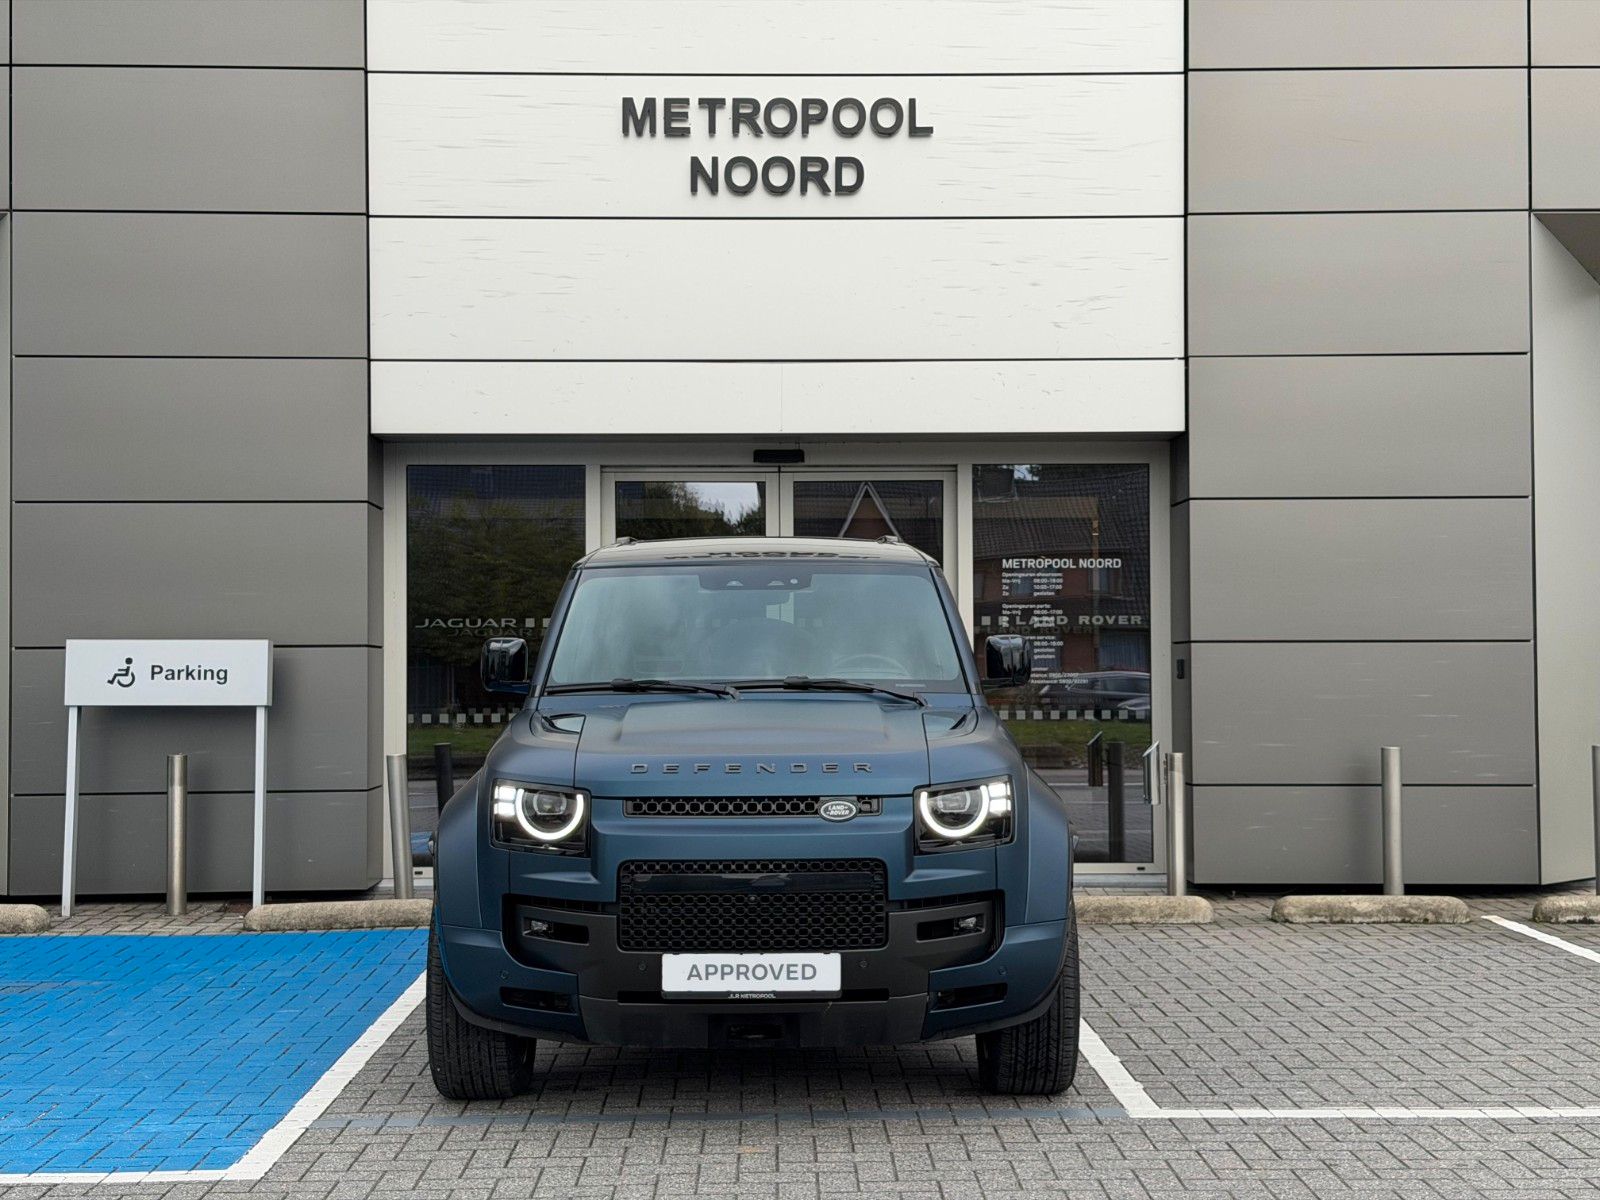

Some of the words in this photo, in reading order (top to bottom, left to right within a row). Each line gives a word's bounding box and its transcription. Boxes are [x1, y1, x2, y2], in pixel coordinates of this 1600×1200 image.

[622, 97, 934, 137] METROPOOL
[690, 155, 865, 195] NOORD
[1002, 558, 1077, 569] METROPOOL
[1079, 558, 1122, 569] NOORD
[415, 618, 517, 628] JAGUAR
[1079, 615, 1142, 625] ROVER
[151, 665, 229, 685] Parking
[631, 763, 873, 774] DEFENDER
[687, 963, 817, 981] APPROVED
